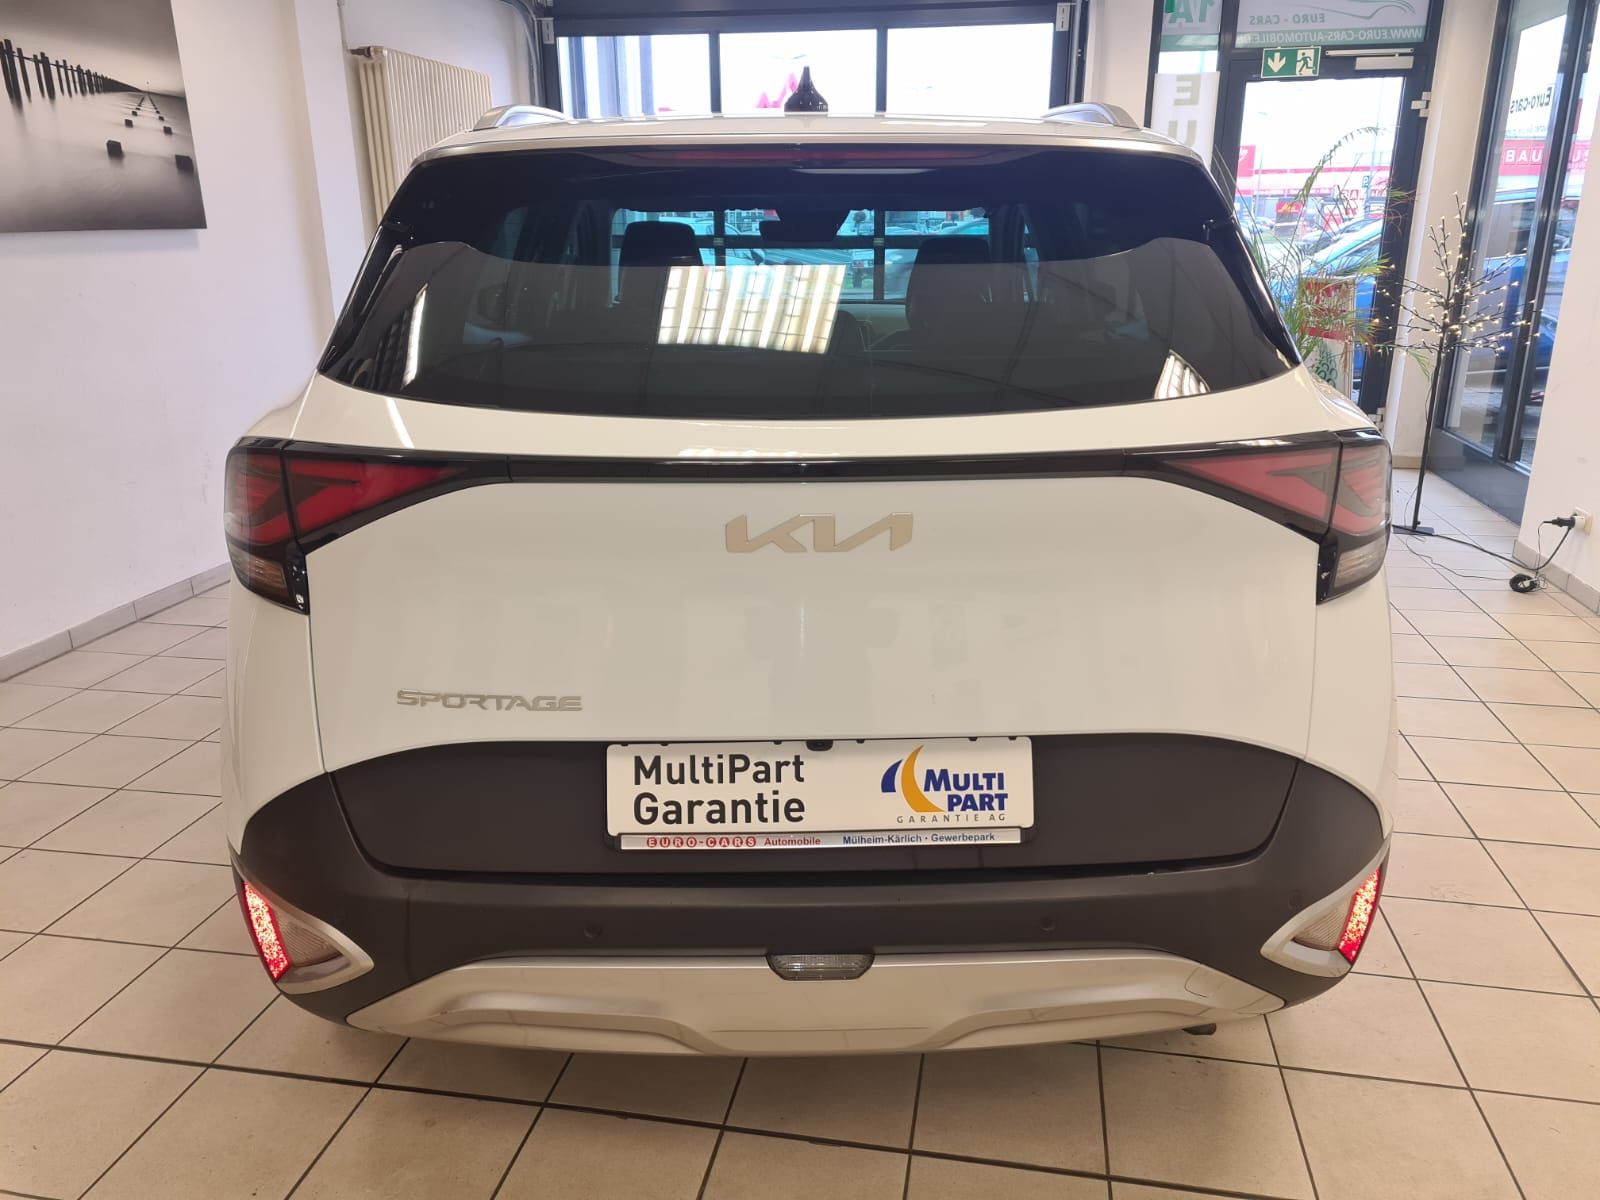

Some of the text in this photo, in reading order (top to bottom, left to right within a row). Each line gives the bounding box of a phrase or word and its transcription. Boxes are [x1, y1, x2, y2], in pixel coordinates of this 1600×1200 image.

[725, 511, 914, 553] KIA
[396, 689, 583, 711] SPORTAGE
[633, 754, 805, 785] MultiPart
[924, 768, 1005, 792] MULTI
[633, 791, 806, 825] Garantie
[947, 793, 1008, 812] PART
[896, 813, 1005, 824] GARANTIE AG
[646, 833, 995, 848] EURO-CARS Automobile Mülheim-Kärlich Gewerbepark
